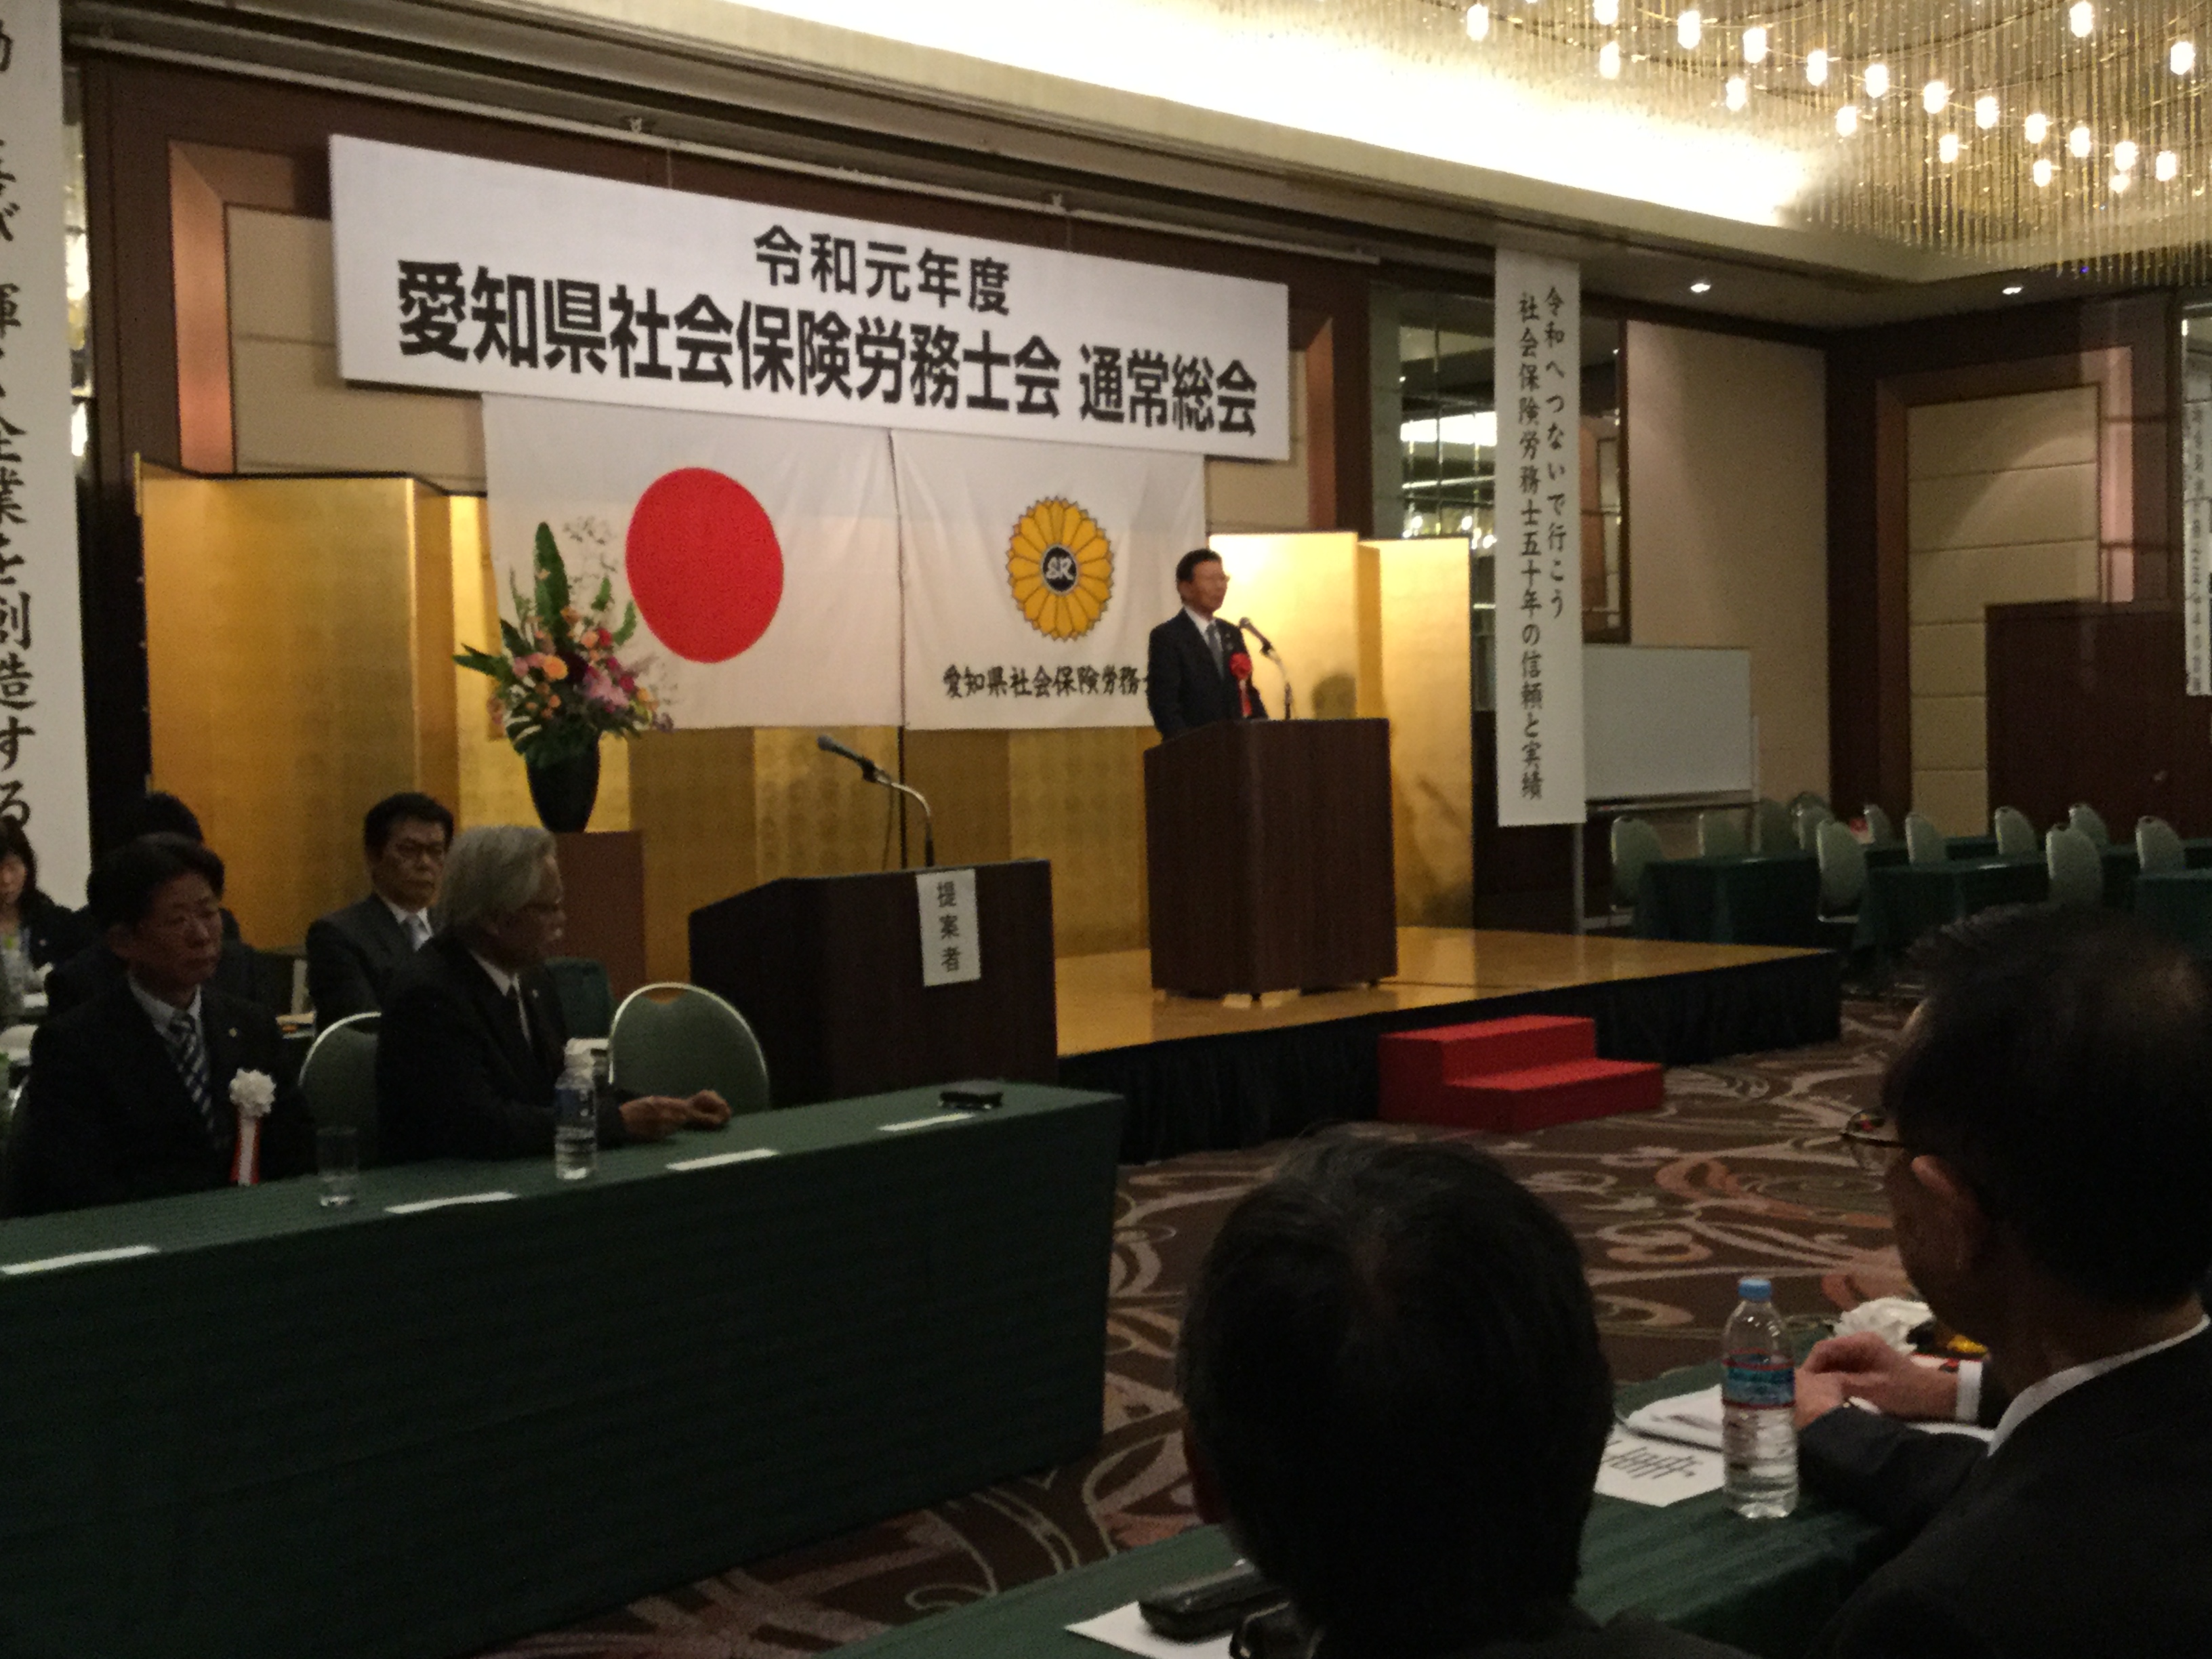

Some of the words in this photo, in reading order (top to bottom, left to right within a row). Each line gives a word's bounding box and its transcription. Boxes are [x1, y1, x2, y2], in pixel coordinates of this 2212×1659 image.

[752, 224, 1011, 316] 令和元年度
[396, 259, 1062, 418] 愛知県社会保険労務士会
[1079, 343, 1258, 437] 通常総会
[1519, 293, 1543, 800] 社会保険労務士五十年の信頼と実績
[943, 663, 1149, 698] 愛知県社会保険労務
[937, 881, 962, 972] 提案者
